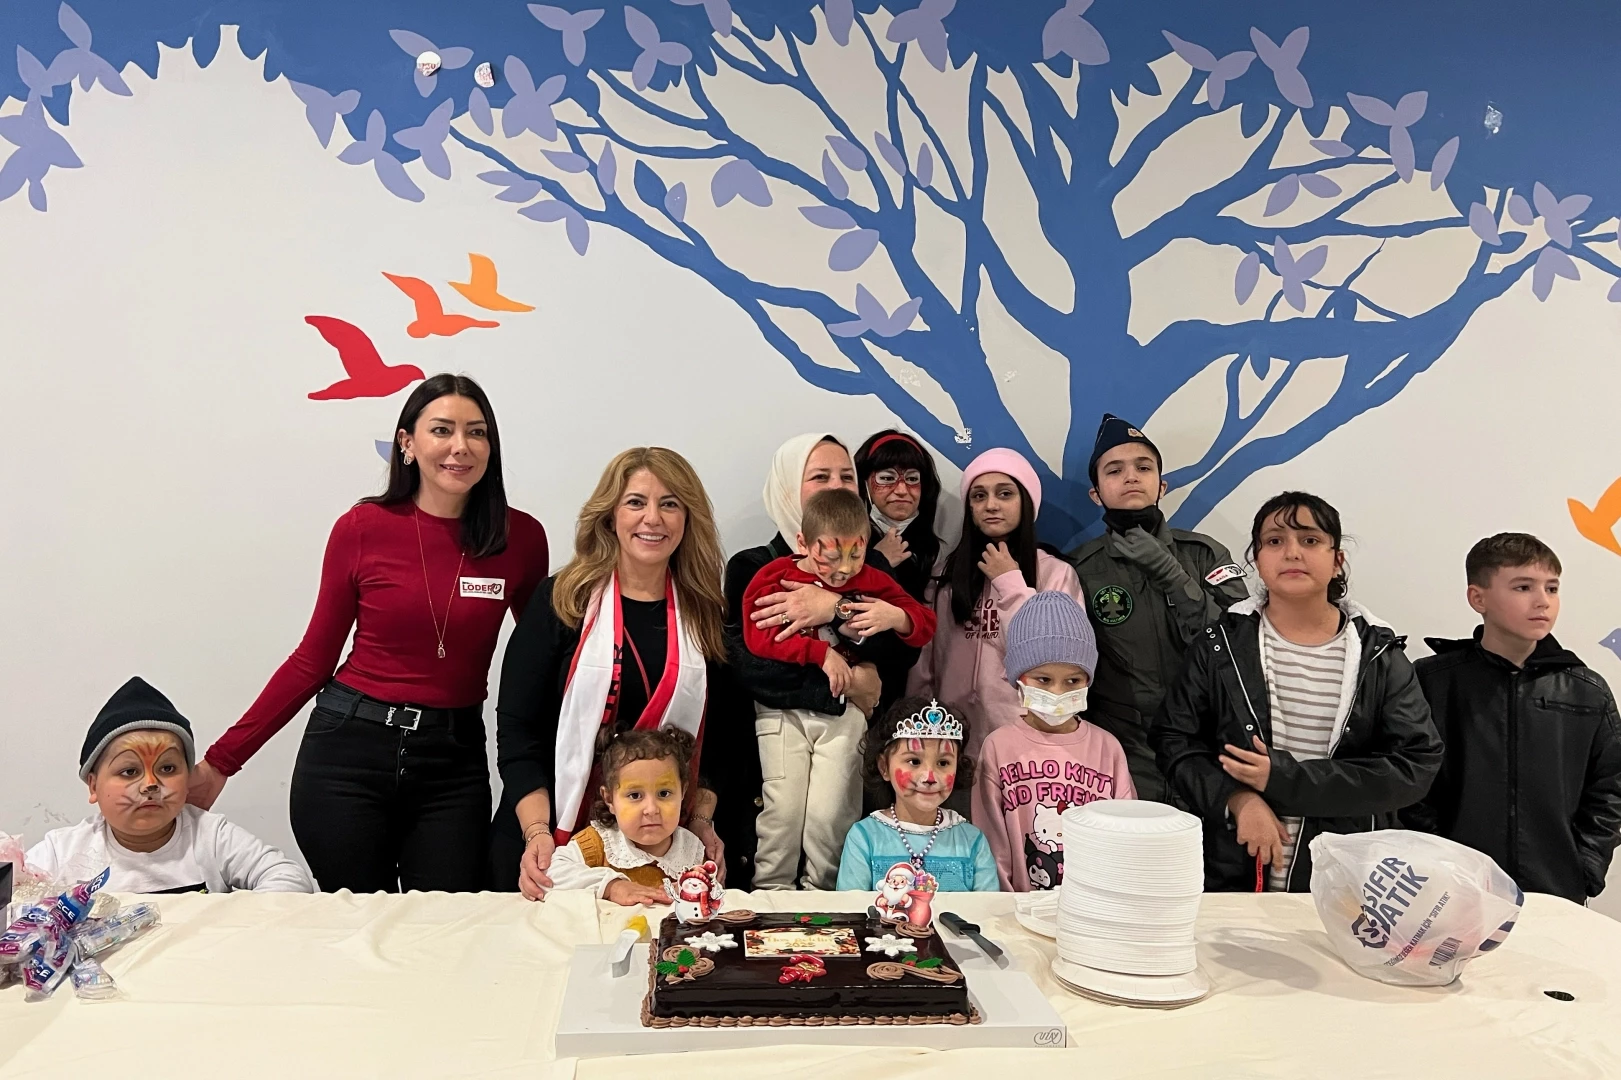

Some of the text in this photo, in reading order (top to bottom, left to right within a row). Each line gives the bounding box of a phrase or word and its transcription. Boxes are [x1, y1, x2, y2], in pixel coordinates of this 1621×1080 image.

[1065, 761, 1114, 799] KITT
[1379, 864, 1430, 927] ATIK
[1410, 926, 1427, 947] KATMAK
